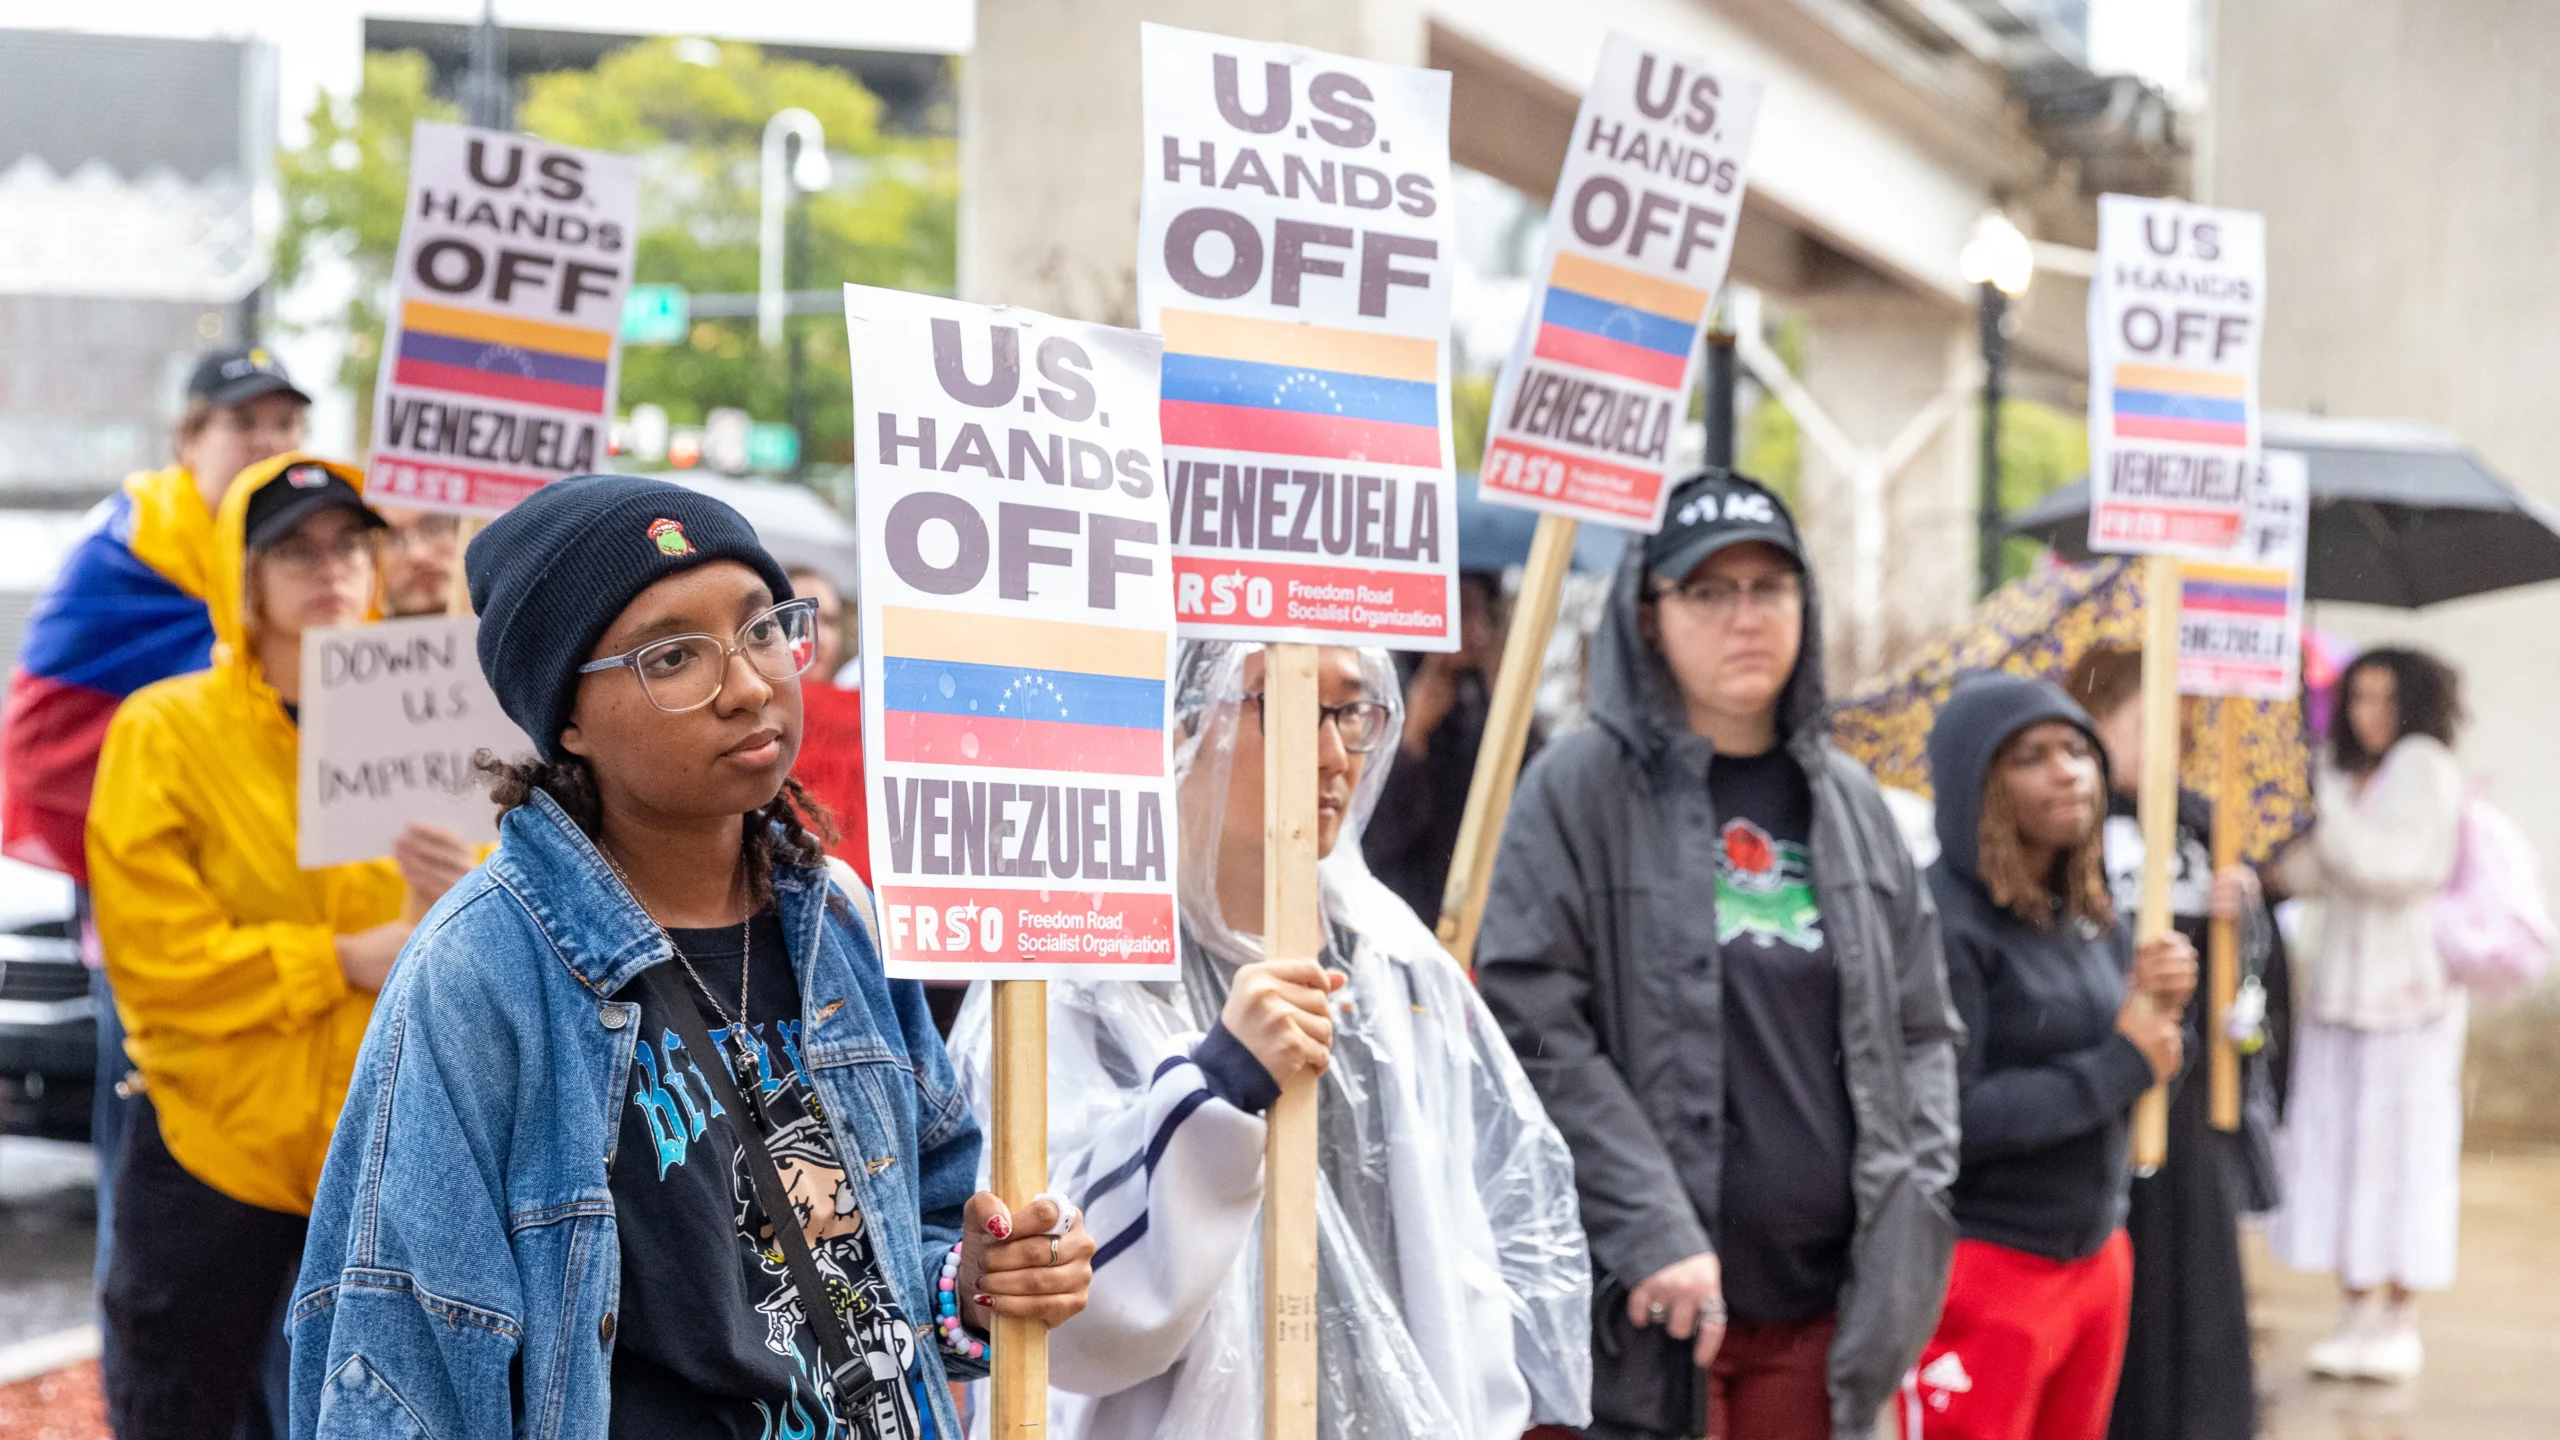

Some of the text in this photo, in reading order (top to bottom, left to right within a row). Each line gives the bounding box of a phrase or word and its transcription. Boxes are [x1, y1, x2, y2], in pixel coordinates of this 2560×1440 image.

[1213, 53, 1390, 153] U.S.
[1635, 53, 1721, 141] U.S.
[1163, 136, 1437, 218] HANDS
[1586, 116, 1736, 194] HANDS
[421, 190, 622, 250] HANDS
[1572, 175, 1726, 271] OFF
[415, 240, 619, 313] OFF
[1164, 207, 1438, 318] OFF
[2121, 306, 2249, 360] OFF
[931, 317, 1109, 427] U.S.
[388, 396, 594, 473] VENEZUELA
[1509, 368, 1671, 463] VENEZUELA
[878, 412, 1154, 498] HANDS
[1164, 459, 1439, 563] VENEZUELA
[885, 491, 1158, 609] OFF
[1173, 571, 1273, 618] RSO
[1287, 602, 1442, 628] Socialist Organization
[1288, 581, 1394, 604] Freedom Road
[321, 634, 456, 688] DOWN
[402, 683, 469, 726] US
[883, 776, 1166, 881] VENEZUELA
[888, 903, 1003, 952] FRSO
[1018, 909, 1123, 931] Freedom Road
[1018, 932, 1170, 956] Socialist Organization
